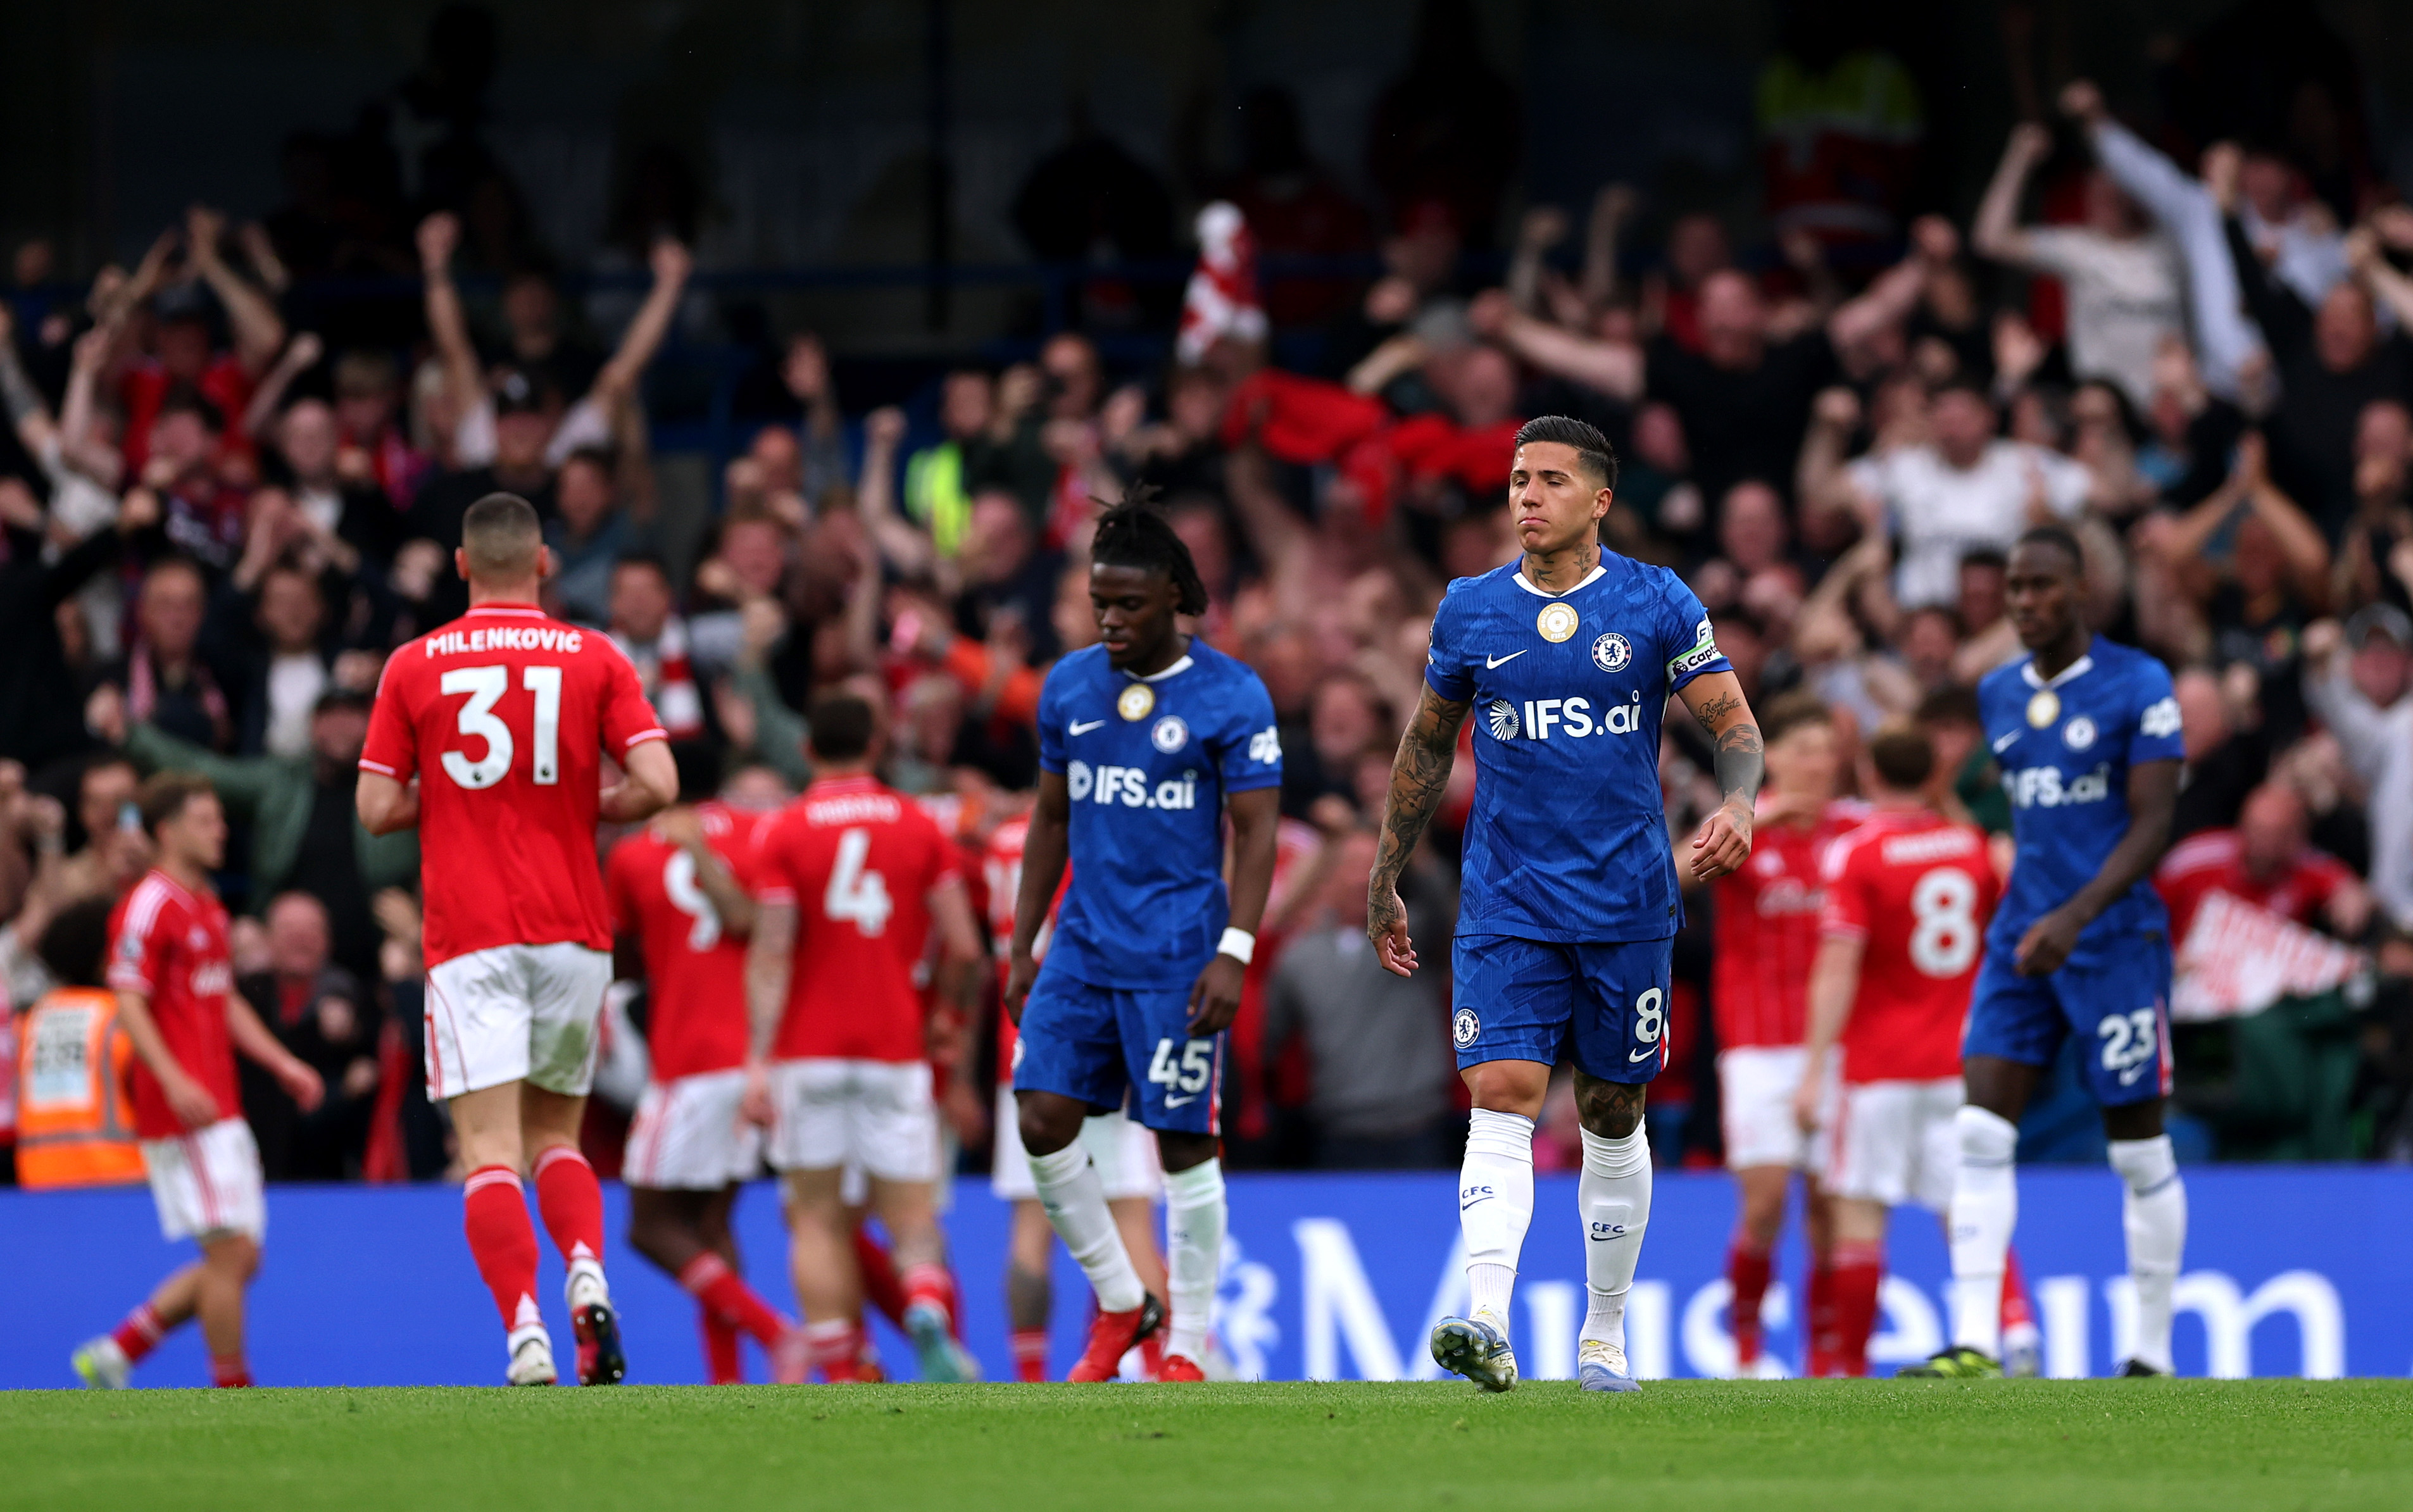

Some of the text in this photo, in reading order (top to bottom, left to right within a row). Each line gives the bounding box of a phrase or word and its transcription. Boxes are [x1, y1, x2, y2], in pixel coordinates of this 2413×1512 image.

[425, 627, 583, 659] MILENKOVIĆ
[1541, 605, 1575, 628] WORLD CHAMPIONS
[1598, 634, 1624, 643] CHELSEA
[441, 664, 563, 790] 31
[1524, 689, 1641, 740] IFS.ai
[1094, 767, 1198, 810] IFS.ai
[825, 827, 894, 939] 4
[1908, 866, 1980, 979] 8
[1636, 987, 1662, 1043] 8
[2097, 1006, 2157, 1071] 23
[1148, 1037, 1213, 1094] 45
[1462, 1186, 1493, 1199] CFC
[1592, 1221, 1625, 1233] CFC
[1291, 1217, 2347, 1379] Museum
